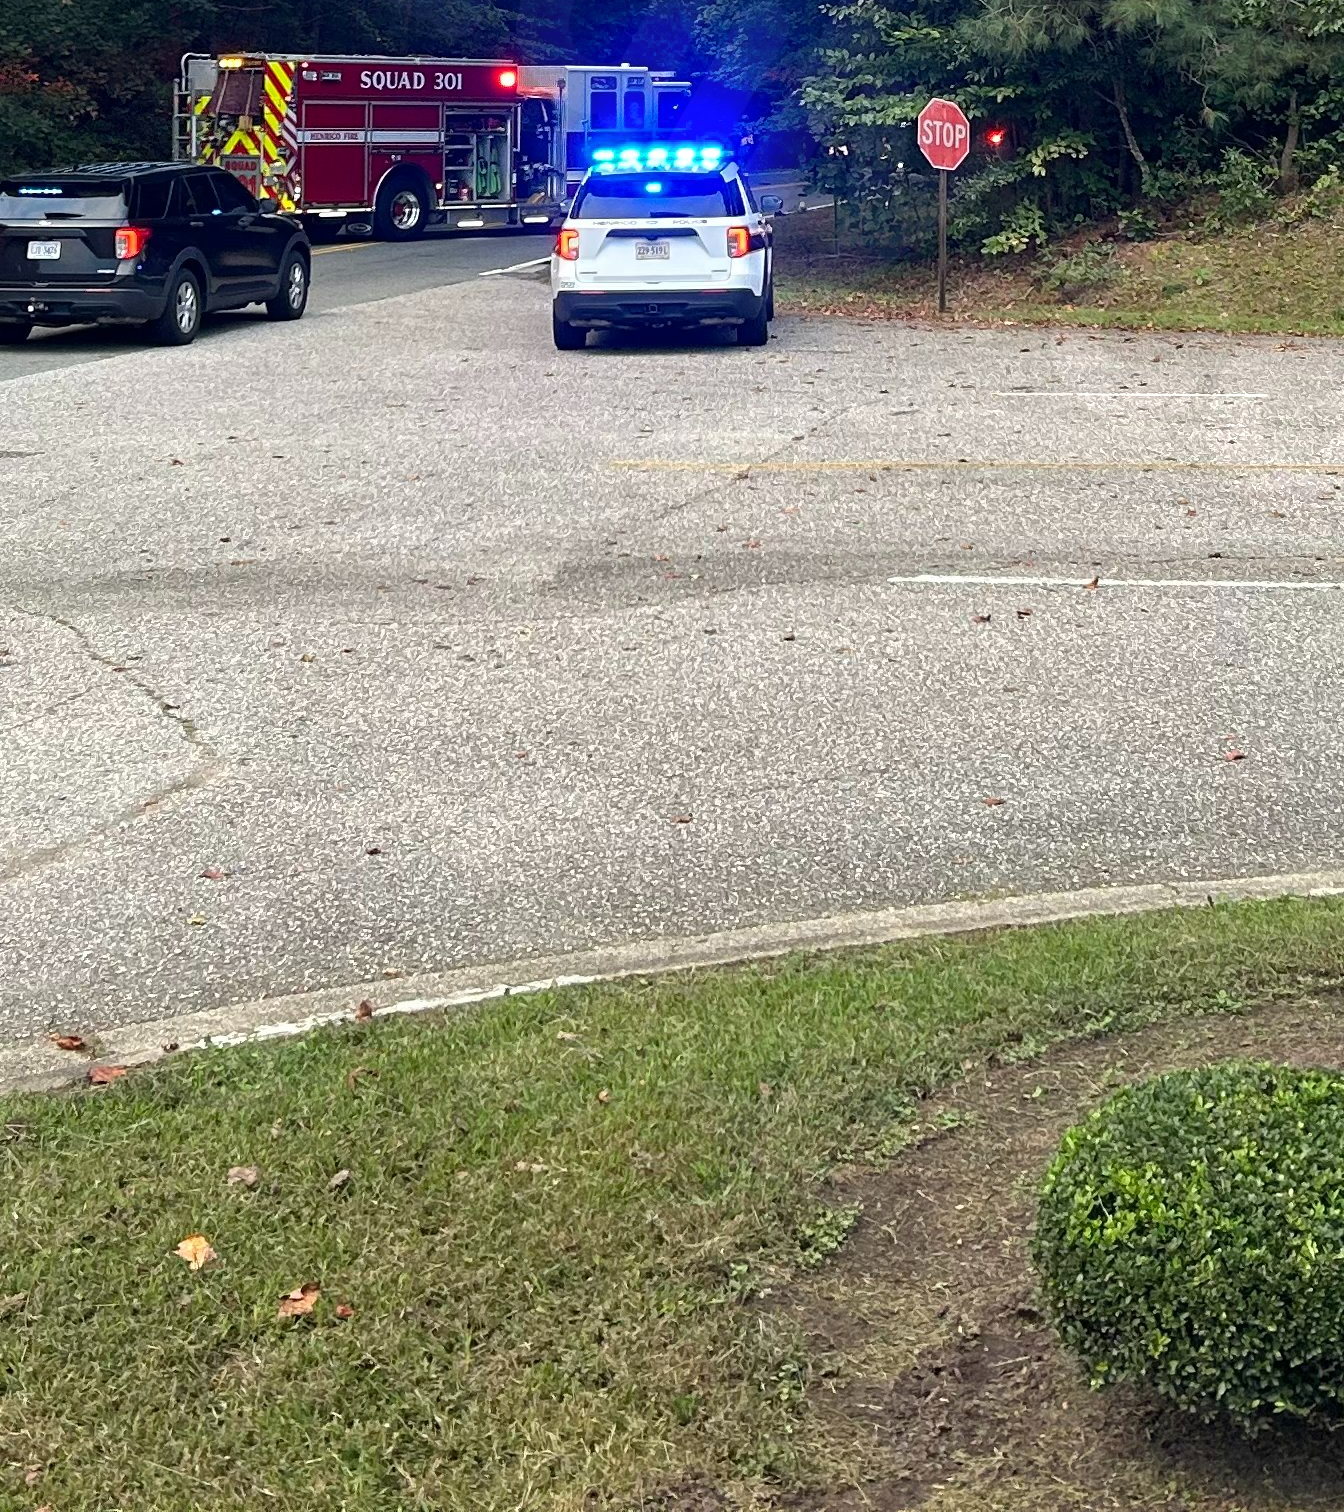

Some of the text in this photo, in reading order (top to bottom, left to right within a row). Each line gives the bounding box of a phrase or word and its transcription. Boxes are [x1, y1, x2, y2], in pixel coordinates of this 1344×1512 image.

[359, 70, 463, 90] SQUAD 301
[310, 132, 358, 140] HENRICO FIRE
[921, 119, 966, 149] STOP
[225, 160, 257, 172] SQUAD
